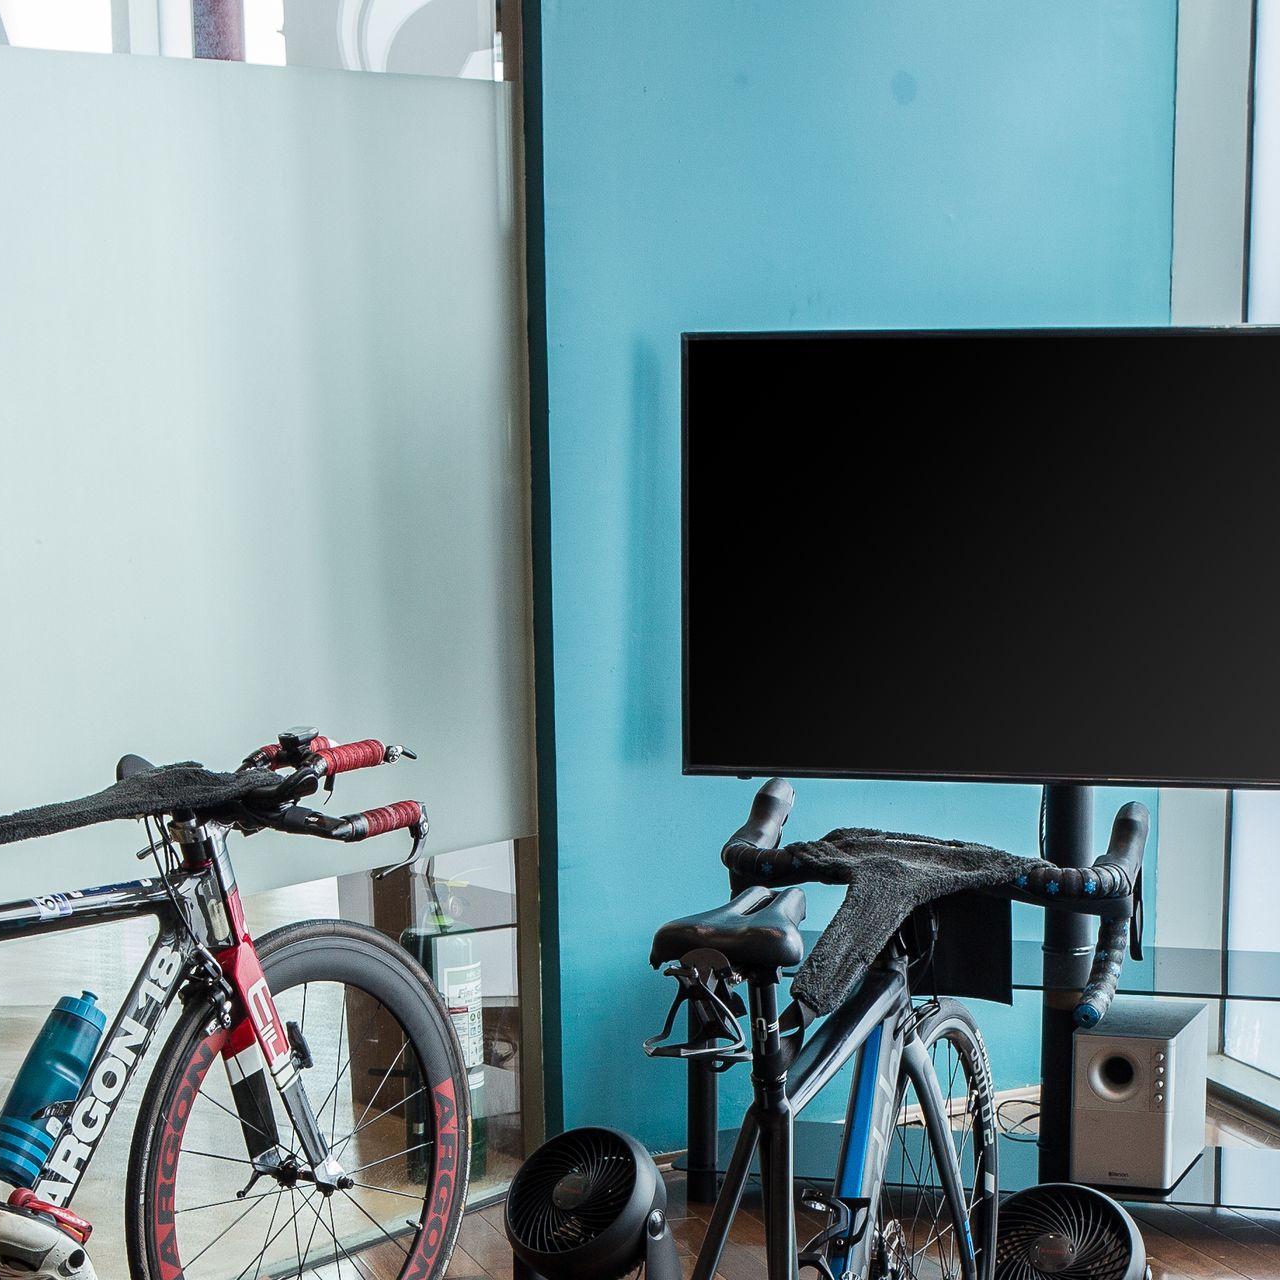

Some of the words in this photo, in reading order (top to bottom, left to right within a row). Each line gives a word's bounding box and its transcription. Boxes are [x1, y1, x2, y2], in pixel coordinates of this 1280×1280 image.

[33, 1015, 150, 1208] ARGON
[137, 945, 182, 1007] 18
[156, 1043, 218, 1271] ARGON
